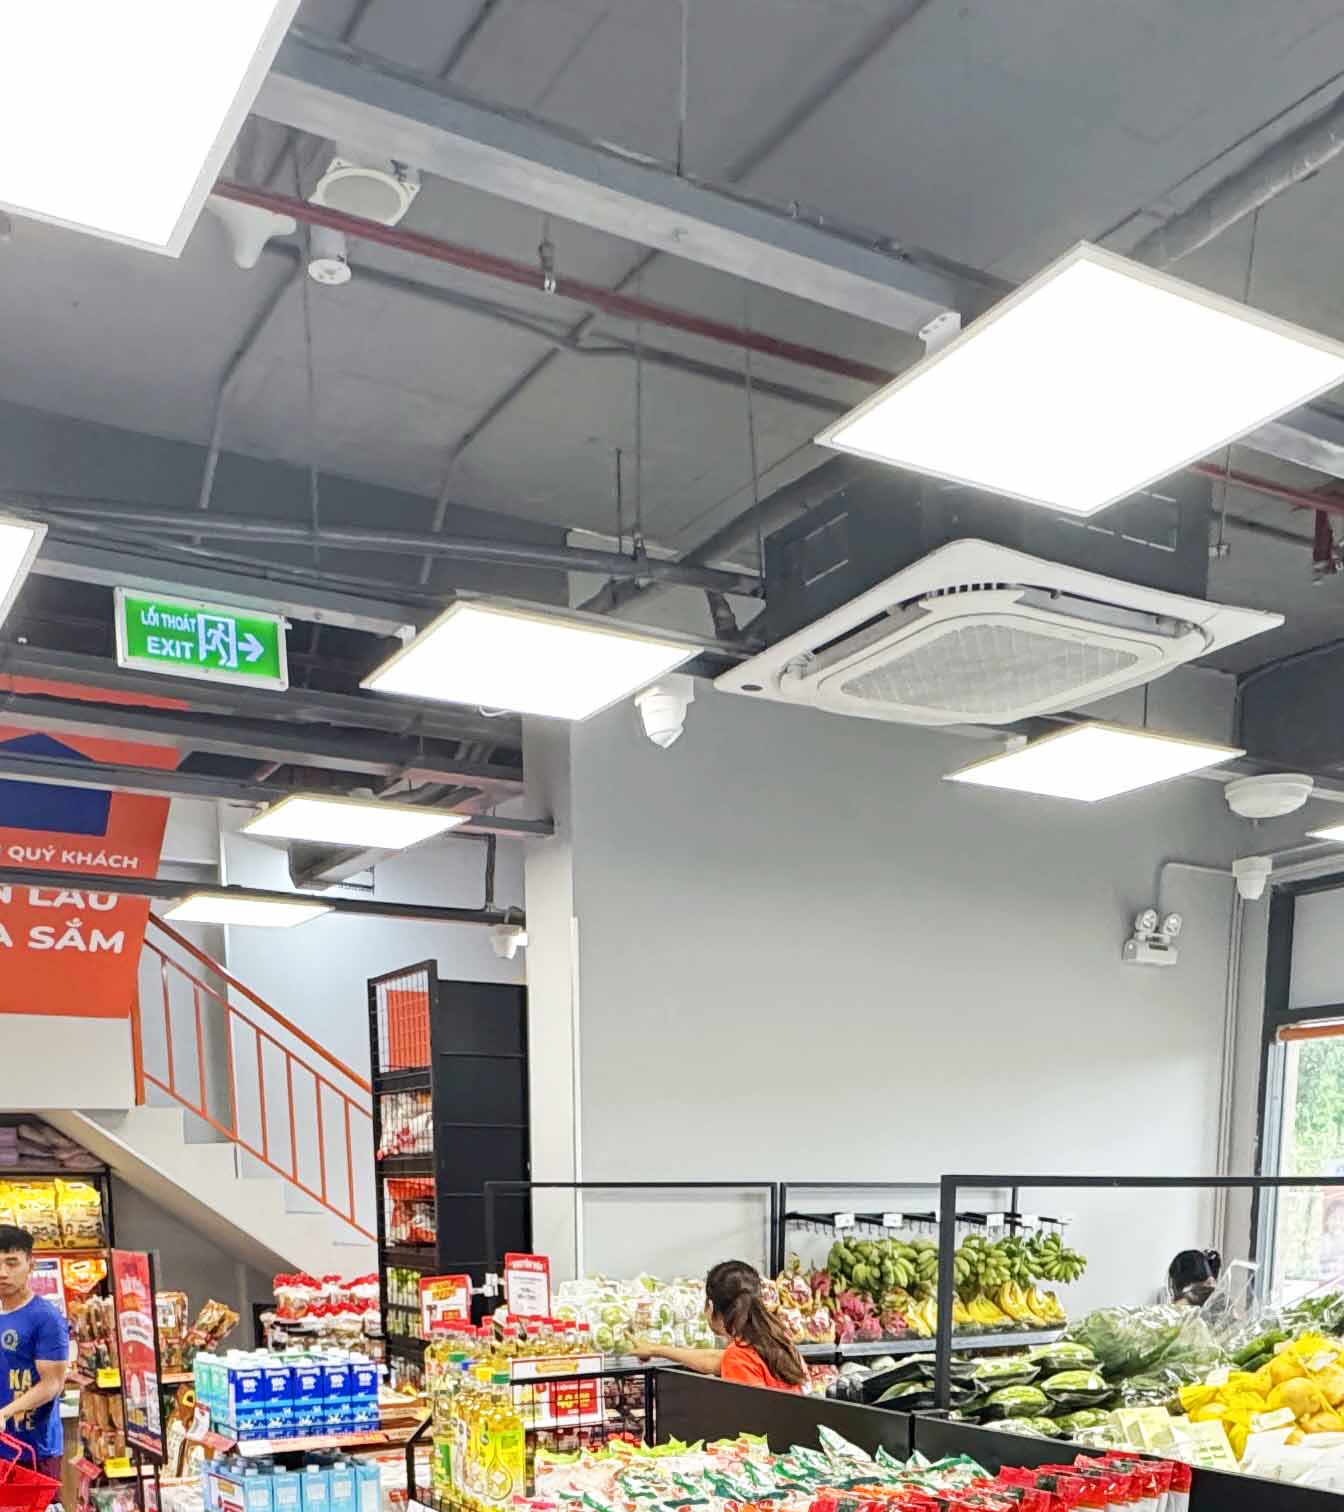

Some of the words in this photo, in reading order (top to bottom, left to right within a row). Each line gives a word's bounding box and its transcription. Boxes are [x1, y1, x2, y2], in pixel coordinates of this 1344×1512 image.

[140, 605, 160, 628] LỐI
[161, 612, 198, 633] THOÁT
[146, 635, 194, 660] EXIT
[7, 844, 56, 864] QUÝ
[61, 849, 140, 870] KHÁCH
